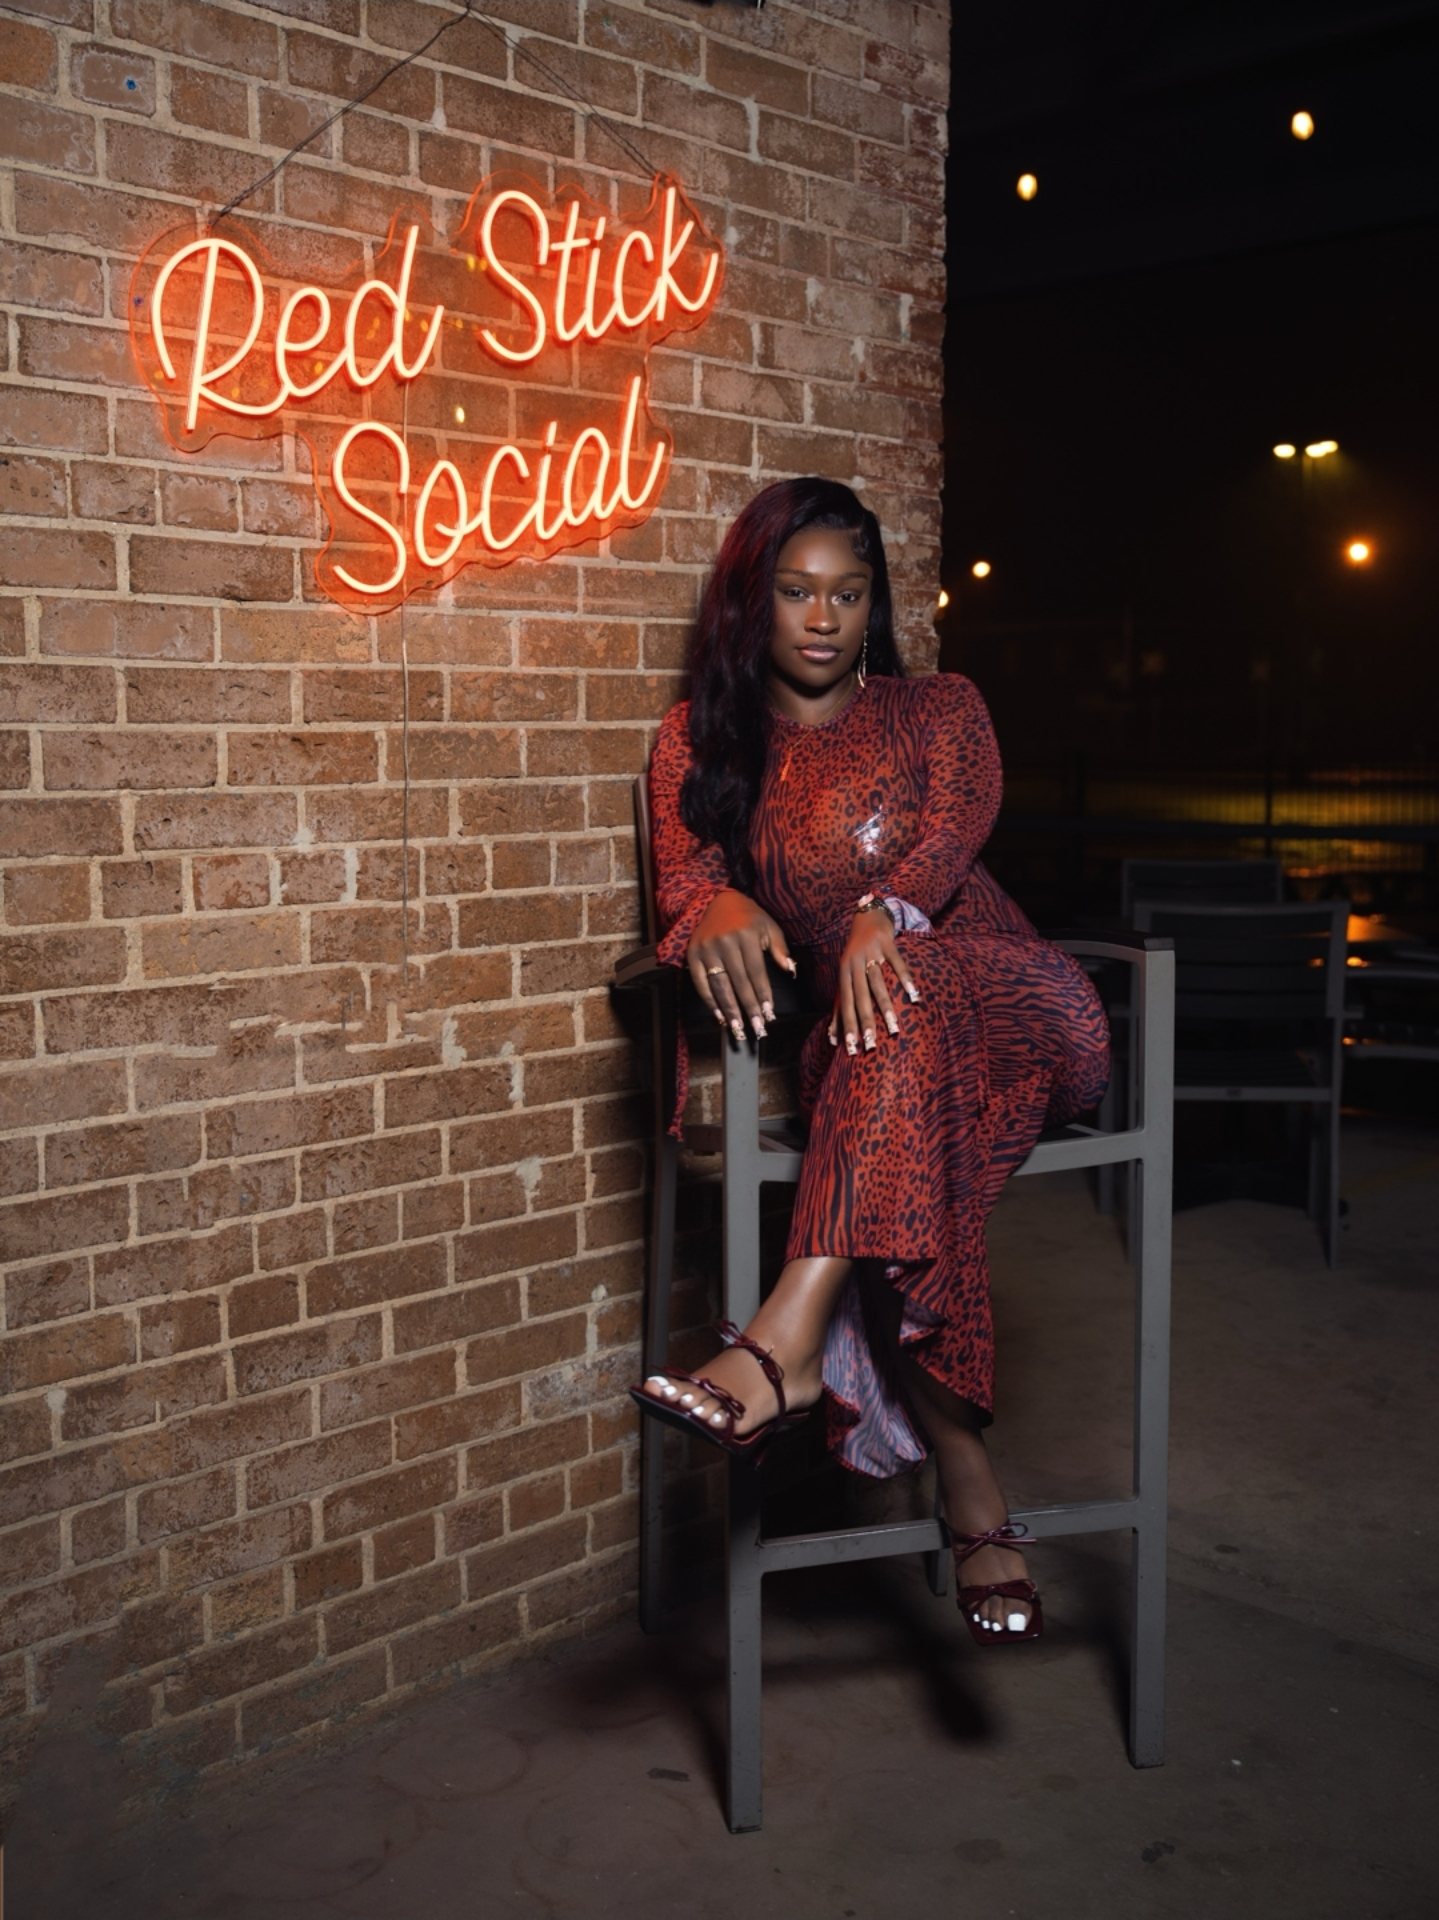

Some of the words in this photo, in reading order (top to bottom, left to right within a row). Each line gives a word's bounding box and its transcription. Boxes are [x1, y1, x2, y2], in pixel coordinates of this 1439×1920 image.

[152, 225, 446, 431] Red
[480, 187, 719, 362] Stick
[332, 376, 665, 593] Social
